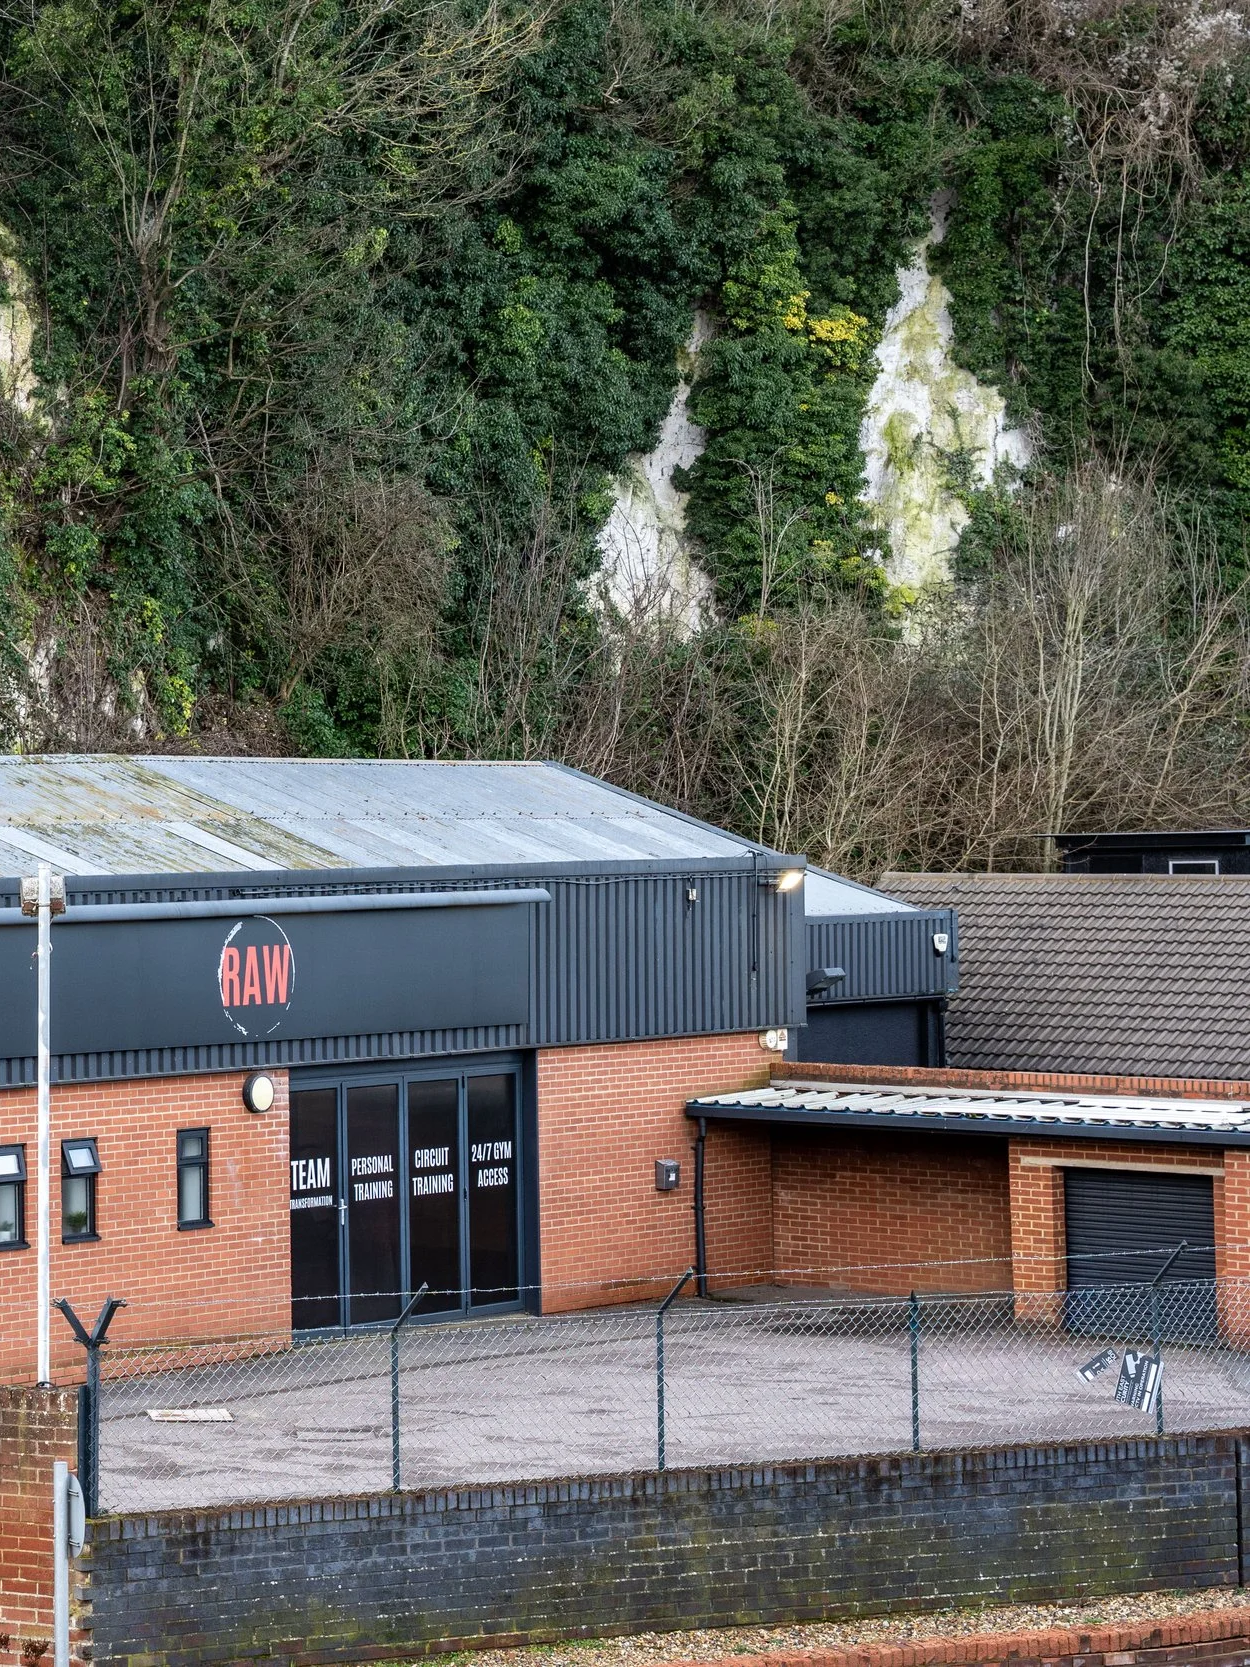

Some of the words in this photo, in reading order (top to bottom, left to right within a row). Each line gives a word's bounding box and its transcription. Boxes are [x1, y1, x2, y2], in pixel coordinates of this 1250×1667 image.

[222, 944, 290, 1007] RAW
[414, 1147, 450, 1168] CIRCUIT
[471, 1142, 492, 1162] 24/7
[493, 1141, 512, 1160] GYM
[291, 1157, 330, 1191] TEAM
[351, 1154, 394, 1177] PERSONAL
[412, 1173, 454, 1196] TRAINING
[477, 1167, 509, 1187] ACCESS
[353, 1180, 394, 1202] TRAINING
[290, 1195, 333, 1210] TRANSFORMATION
[1118, 1374, 1126, 1391] EAST
[1139, 1360, 1149, 1391] OPERATION
